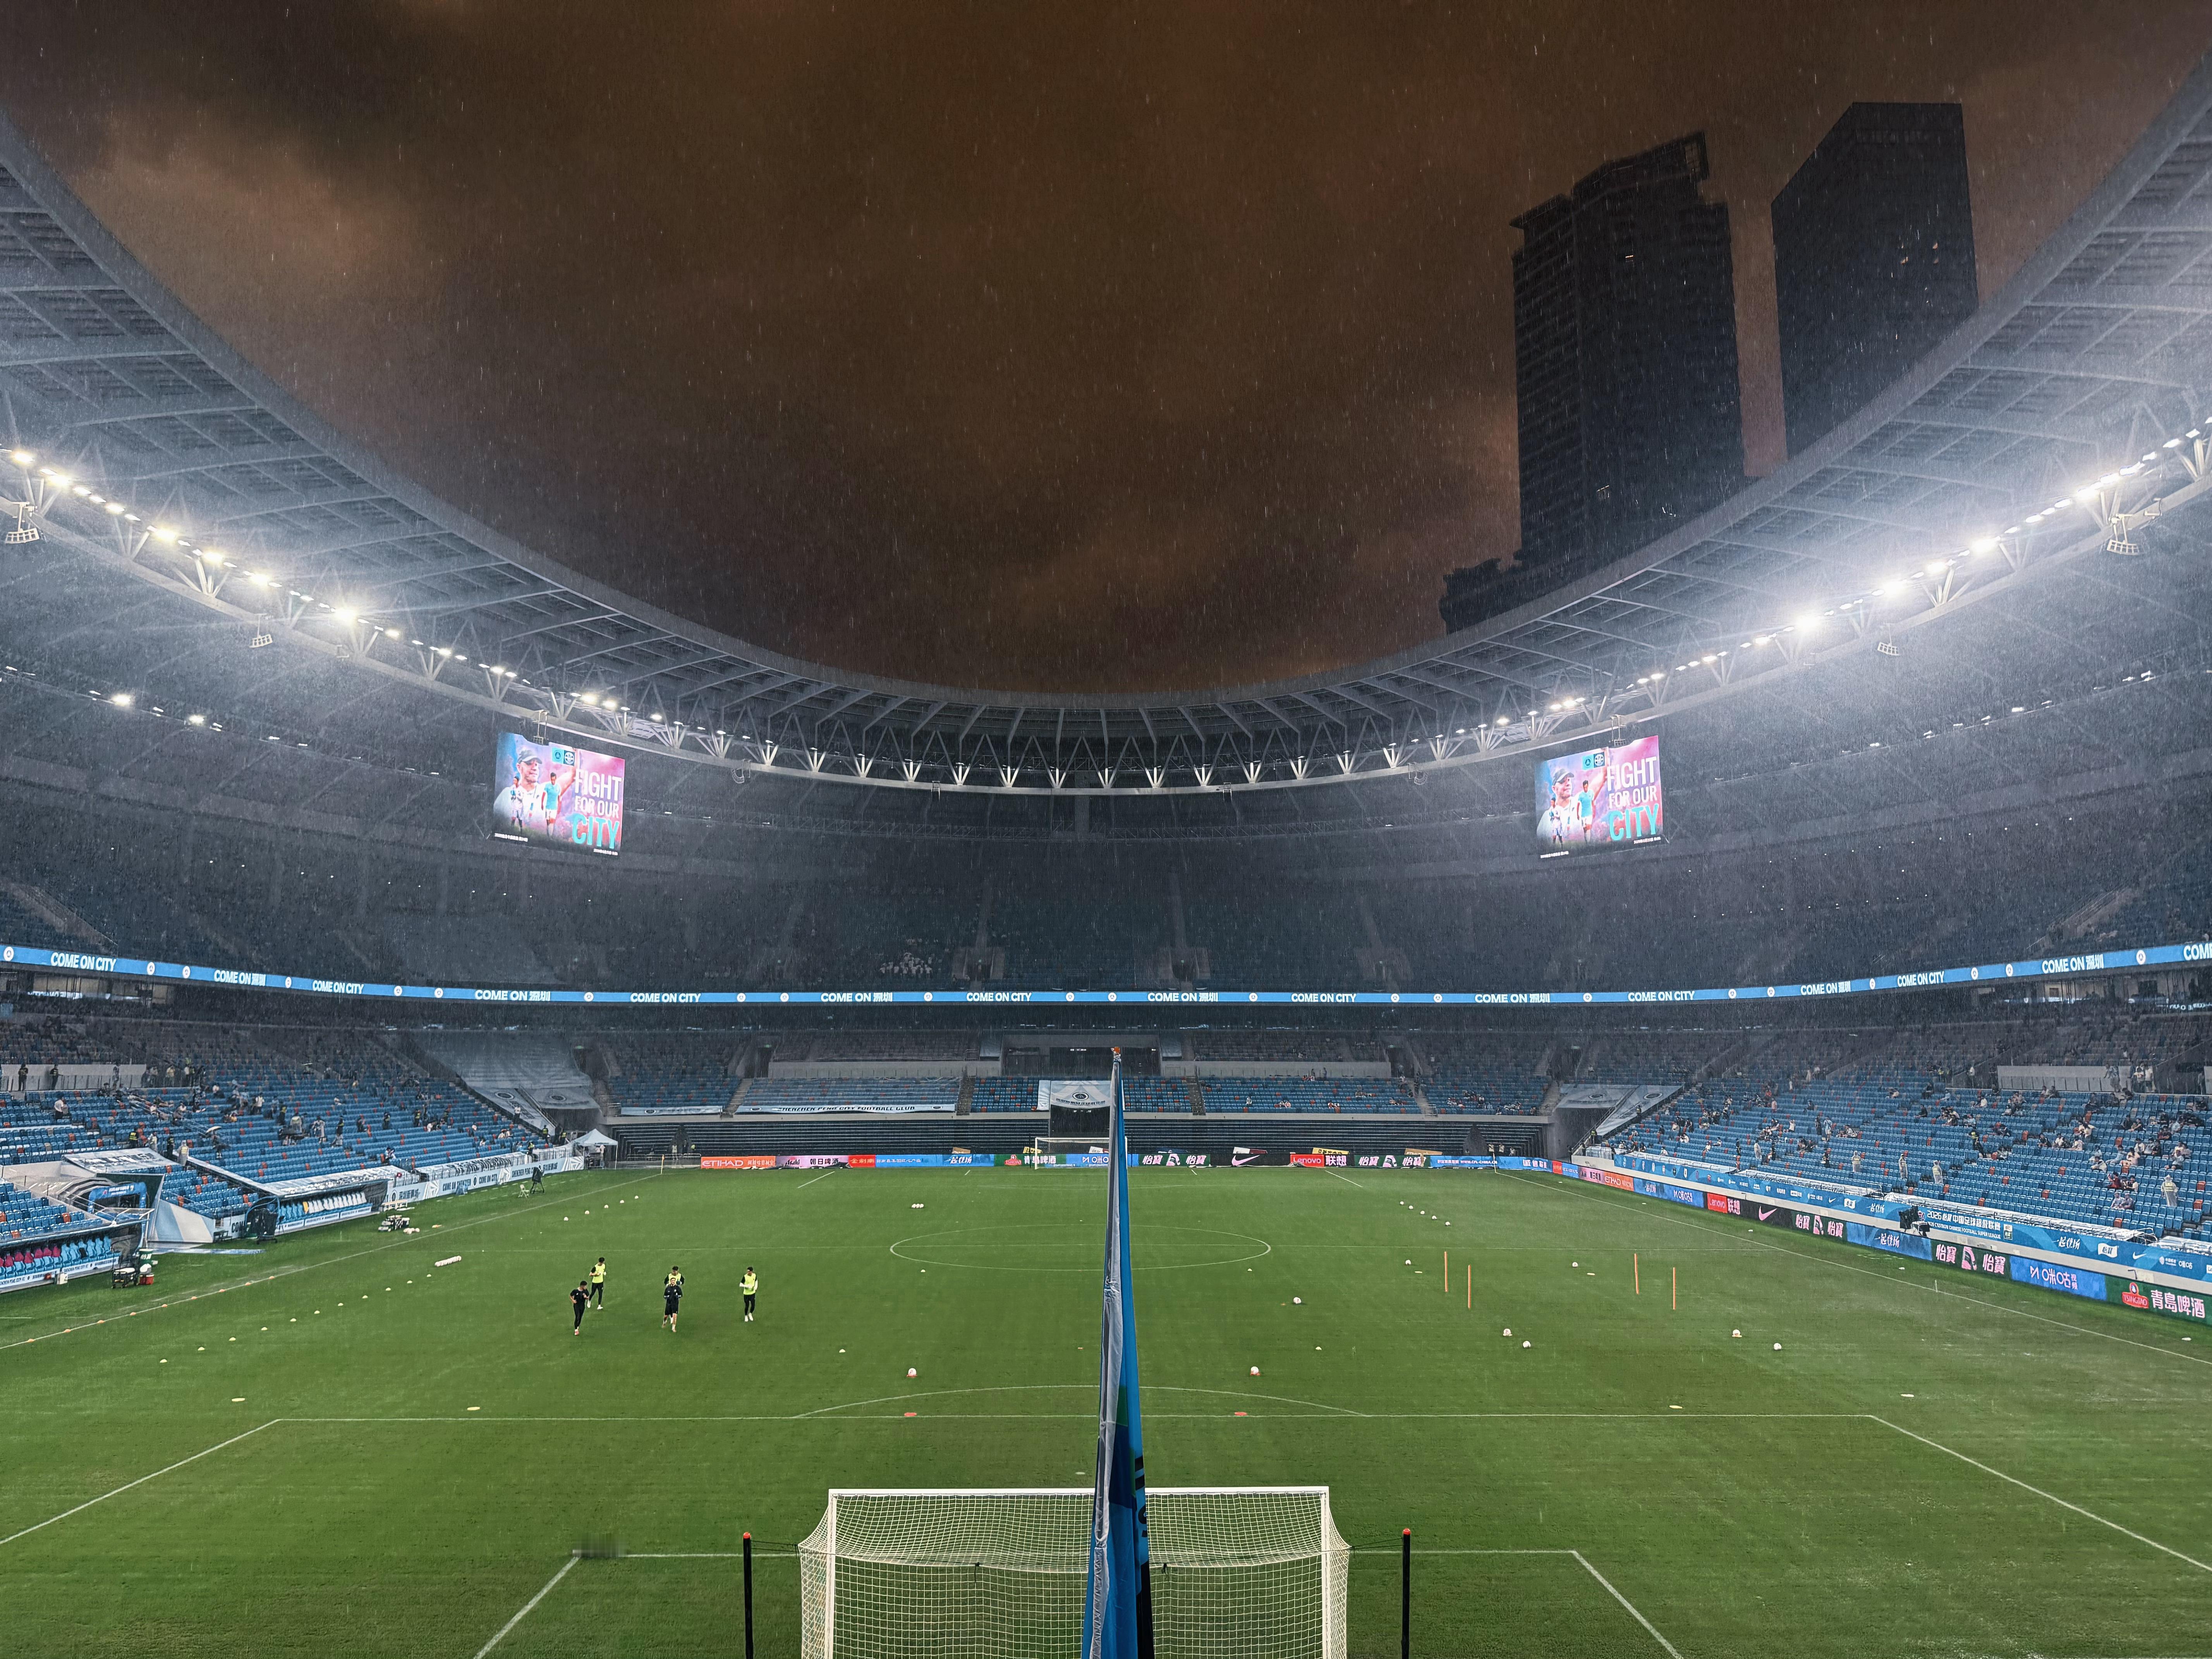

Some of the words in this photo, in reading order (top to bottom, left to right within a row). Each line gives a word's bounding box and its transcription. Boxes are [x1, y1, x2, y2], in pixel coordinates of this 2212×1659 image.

[1607, 756, 1657, 791] FIGHT
[575, 769, 622, 801] FIGHT
[1609, 791, 1630, 809] FOR
[1633, 785, 1657, 804] OUR
[575, 795, 595, 814] FOR
[598, 800, 619, 818] OUR
[1609, 804, 1659, 841] CITY
[572, 813, 619, 849] CITY
[51, 952, 79, 968] COME
[80, 955, 95, 969] ON
[96, 957, 116, 972] CITY
[2042, 958, 2069, 974] COME
[2070, 957, 2085, 971] ON
[2086, 954, 2104, 970] 深圳
[214, 970, 238, 983] COME
[239, 972, 251, 984] ON
[1898, 975, 1917, 987] COME
[1917, 973, 1928, 985] ON
[1929, 971, 1944, 984] CITY
[313, 980, 332, 992] COME
[334, 982, 345, 993] ON
[346, 983, 364, 994] CITY
[1801, 984, 1825, 995] COME
[1826, 983, 1838, 994] ON
[475, 990, 508, 1000] COME
[510, 991, 527, 1001] ON
[630, 993, 660, 1002] COME
[661, 993, 677, 1002] ON
[678, 993, 701, 1002] CITY
[821, 993, 852, 1002] COME
[855, 993, 871, 1002] ON
[873, 992, 893, 1002] 深圳
[967, 992, 994, 1001] COME
[995, 993, 1010, 1001] ON
[1011, 992, 1032, 1001] CITY
[1147, 993, 1179, 1001] COME
[1181, 993, 1197, 1001] ON
[1199, 992, 1218, 1002] 深圳
[1291, 993, 1319, 1002] COME
[1320, 993, 1334, 1002] ON
[1336, 993, 1356, 1002] CITY
[1475, 994, 1508, 1003] COME
[1510, 994, 1527, 1003] ON
[1628, 992, 1656, 1001] COME
[1658, 991, 1672, 1001] ON
[1674, 991, 1695, 1001] CITY
[1326, 1155, 1346, 1166] 联想
[1709, 1197, 1726, 1208] Lenovo
[1728, 1198, 1740, 1214] 联想
[1927, 1210, 1942, 1220] 2026
[2123, 1295, 2148, 1306] TSINGTAO
[2151, 1290, 2205, 1319] 青島啤酒
